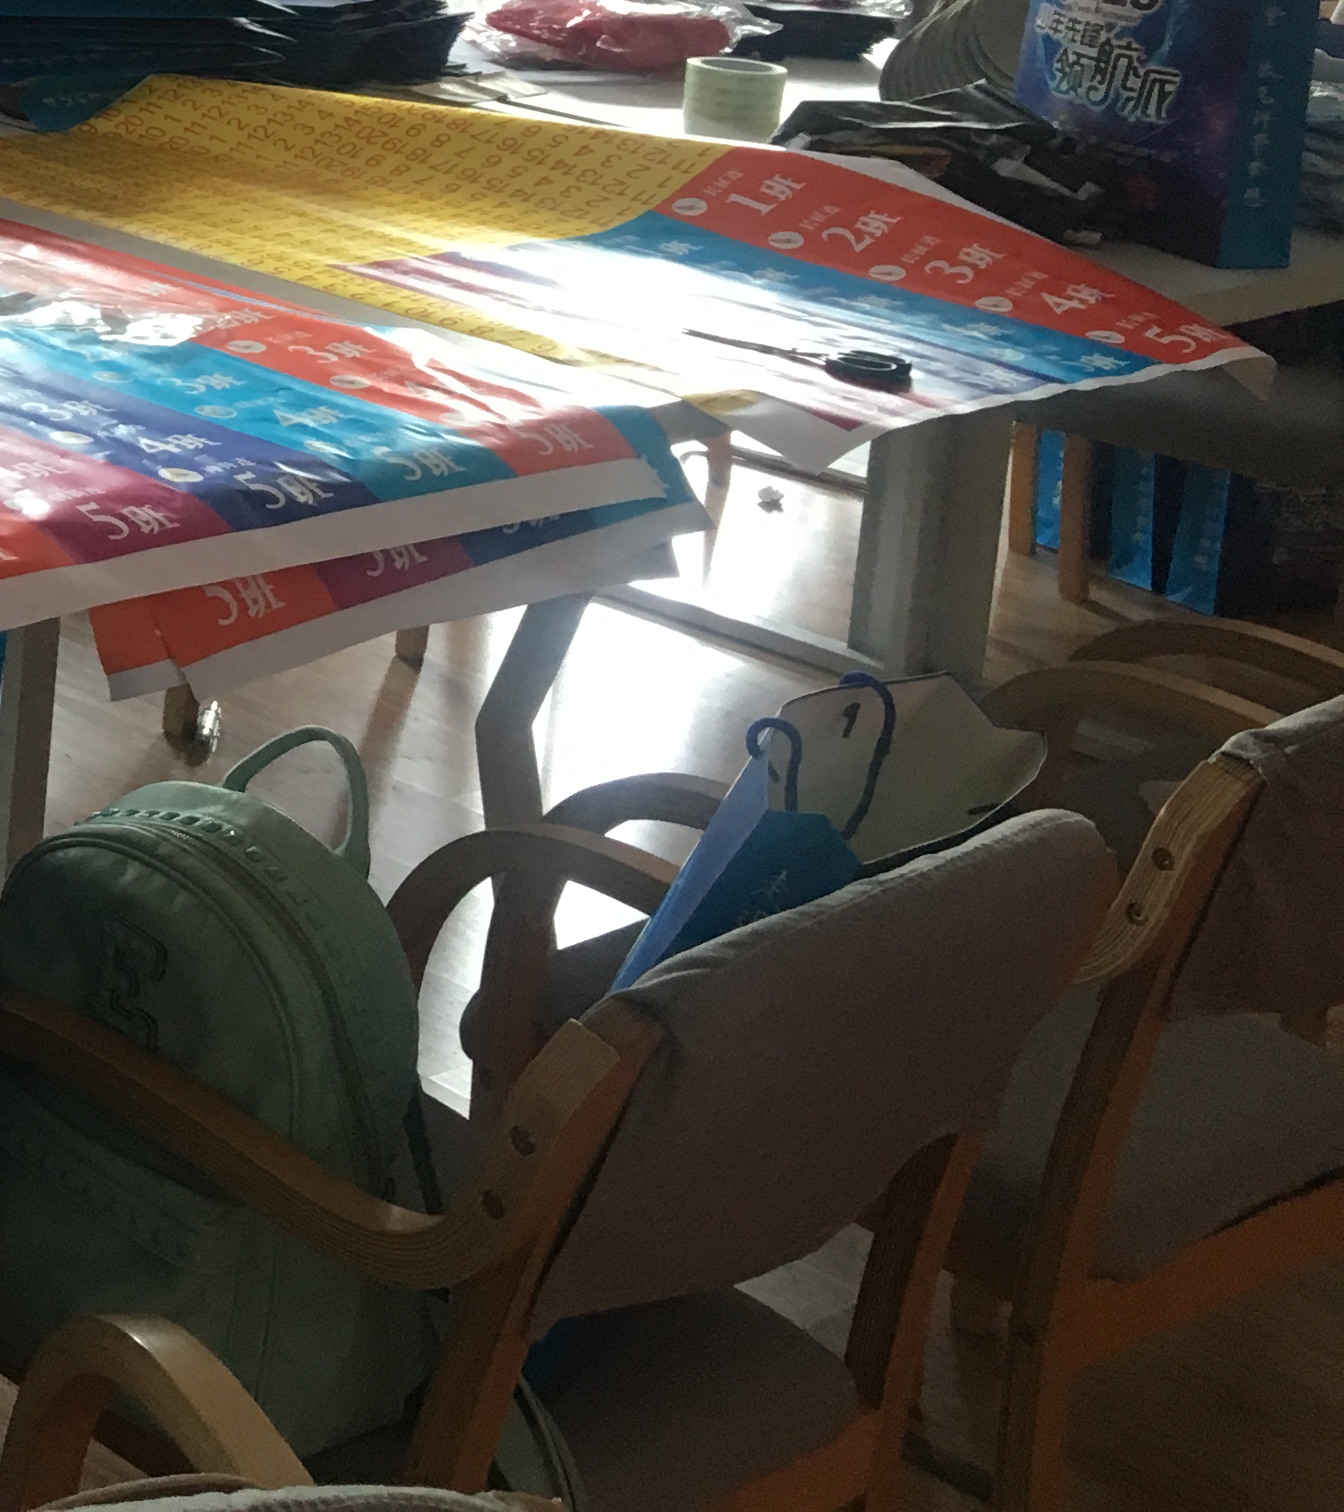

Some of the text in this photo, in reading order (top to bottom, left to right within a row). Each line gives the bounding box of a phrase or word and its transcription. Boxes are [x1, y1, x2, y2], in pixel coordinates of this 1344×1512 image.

[724, 173, 808, 217] 1班
[821, 209, 904, 253] 2班
[924, 242, 1009, 285] 3班
[1040, 282, 1116, 315] 4班
[286, 339, 378, 365] 3班
[1144, 323, 1229, 355] 5班
[20, 398, 116, 422] 3班
[136, 432, 223, 454] 4班
[232, 470, 335, 510] 5班
[75, 500, 181, 541] 5班
